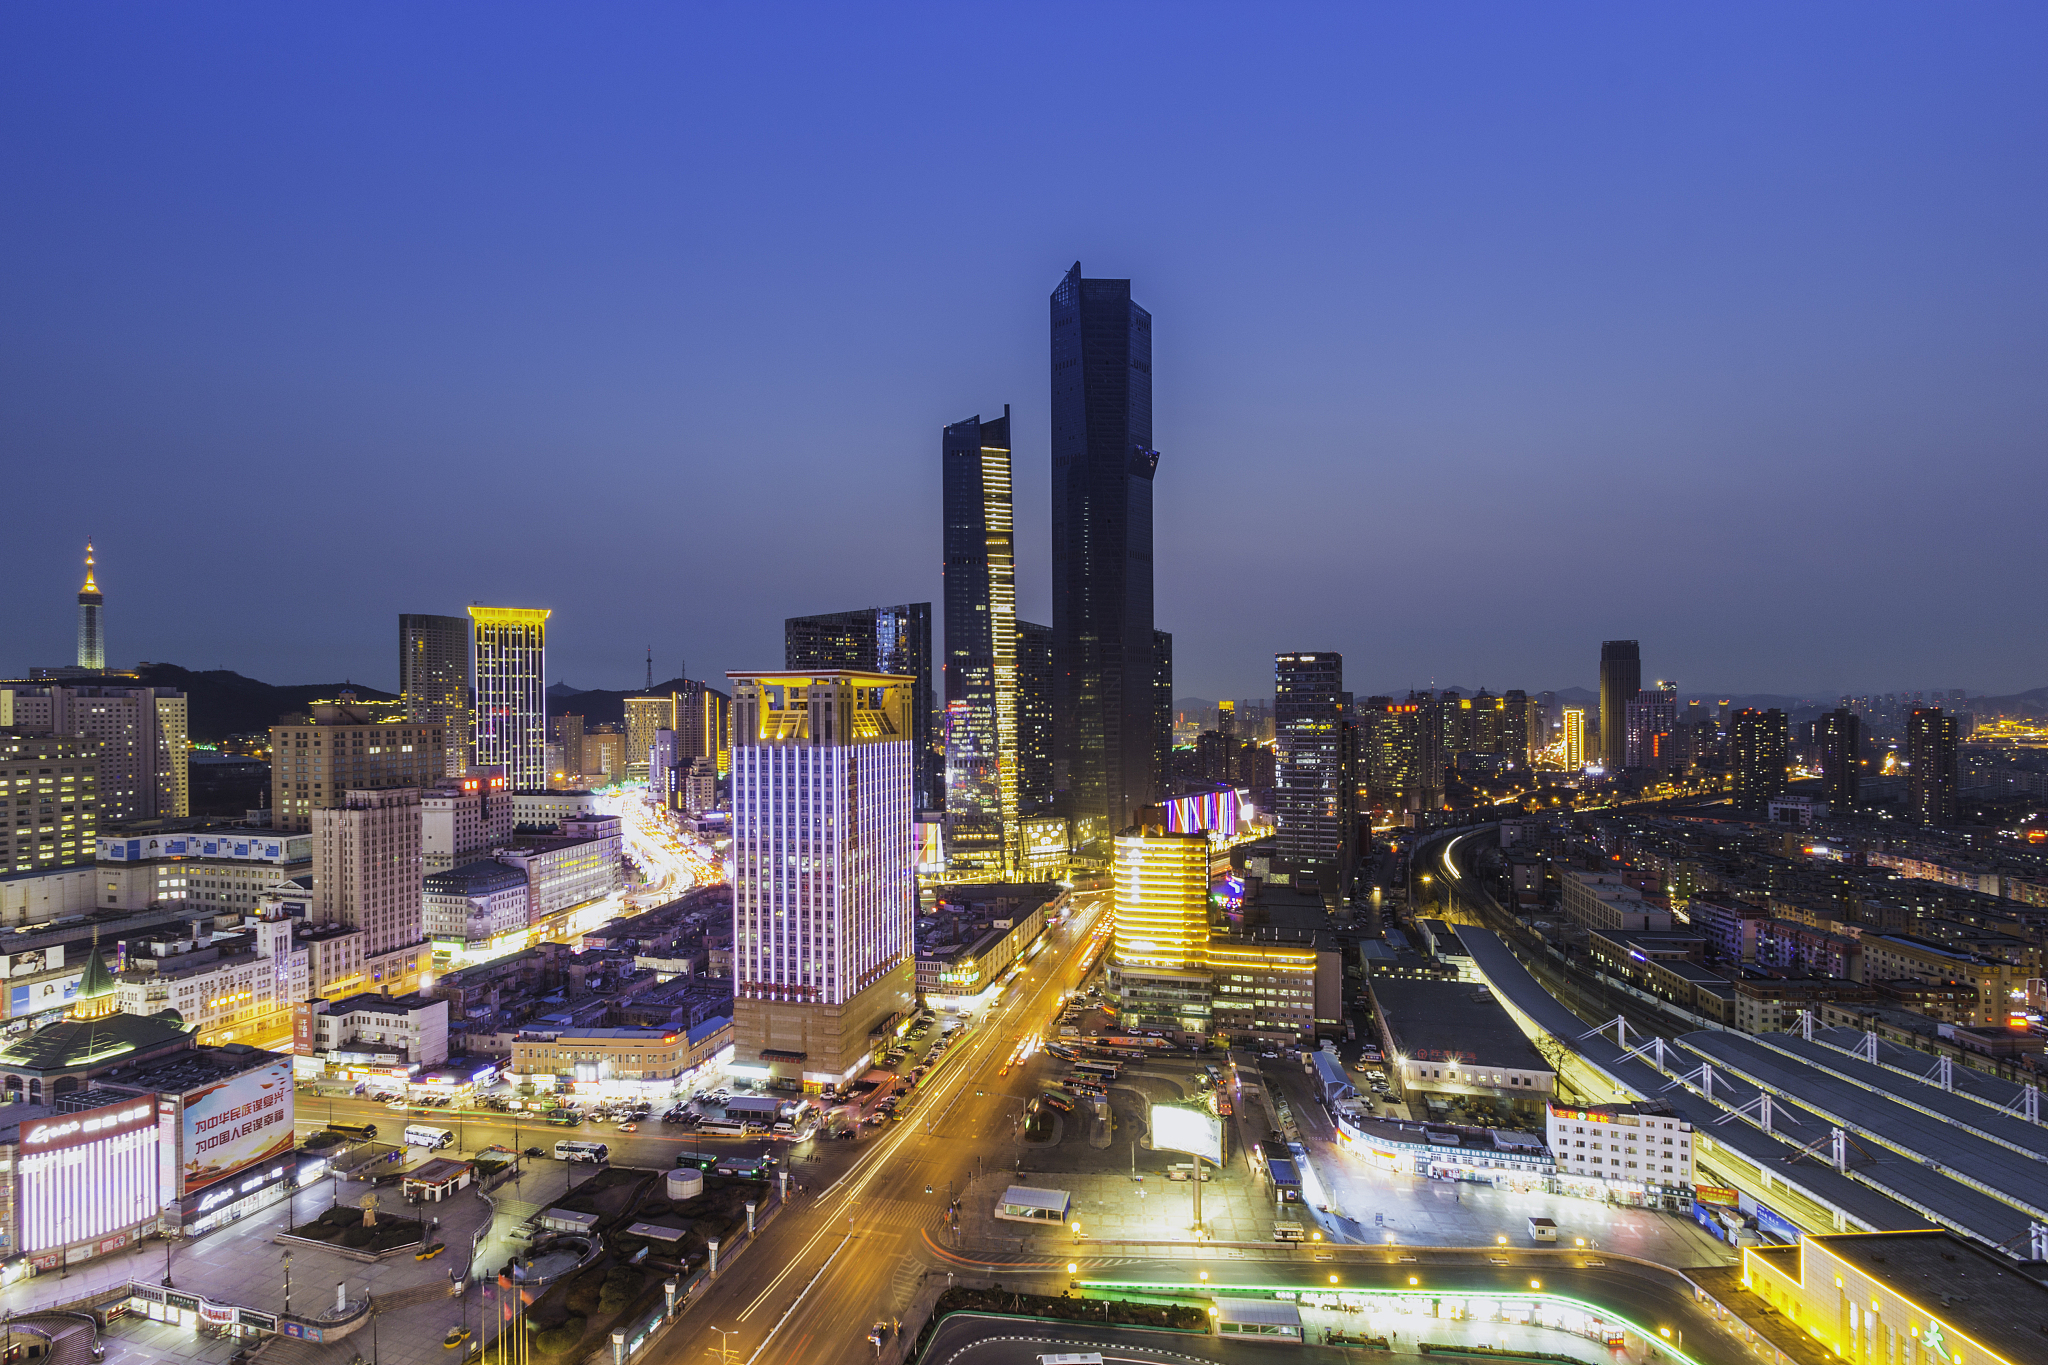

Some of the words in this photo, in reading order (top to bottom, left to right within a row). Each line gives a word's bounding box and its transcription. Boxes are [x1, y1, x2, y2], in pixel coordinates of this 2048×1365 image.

[195, 1088, 285, 1135] 为中华民族谋复兴
[195, 1108, 284, 1155] 为中国人民谋幸福
[1921, 1320, 1951, 1361] 大
